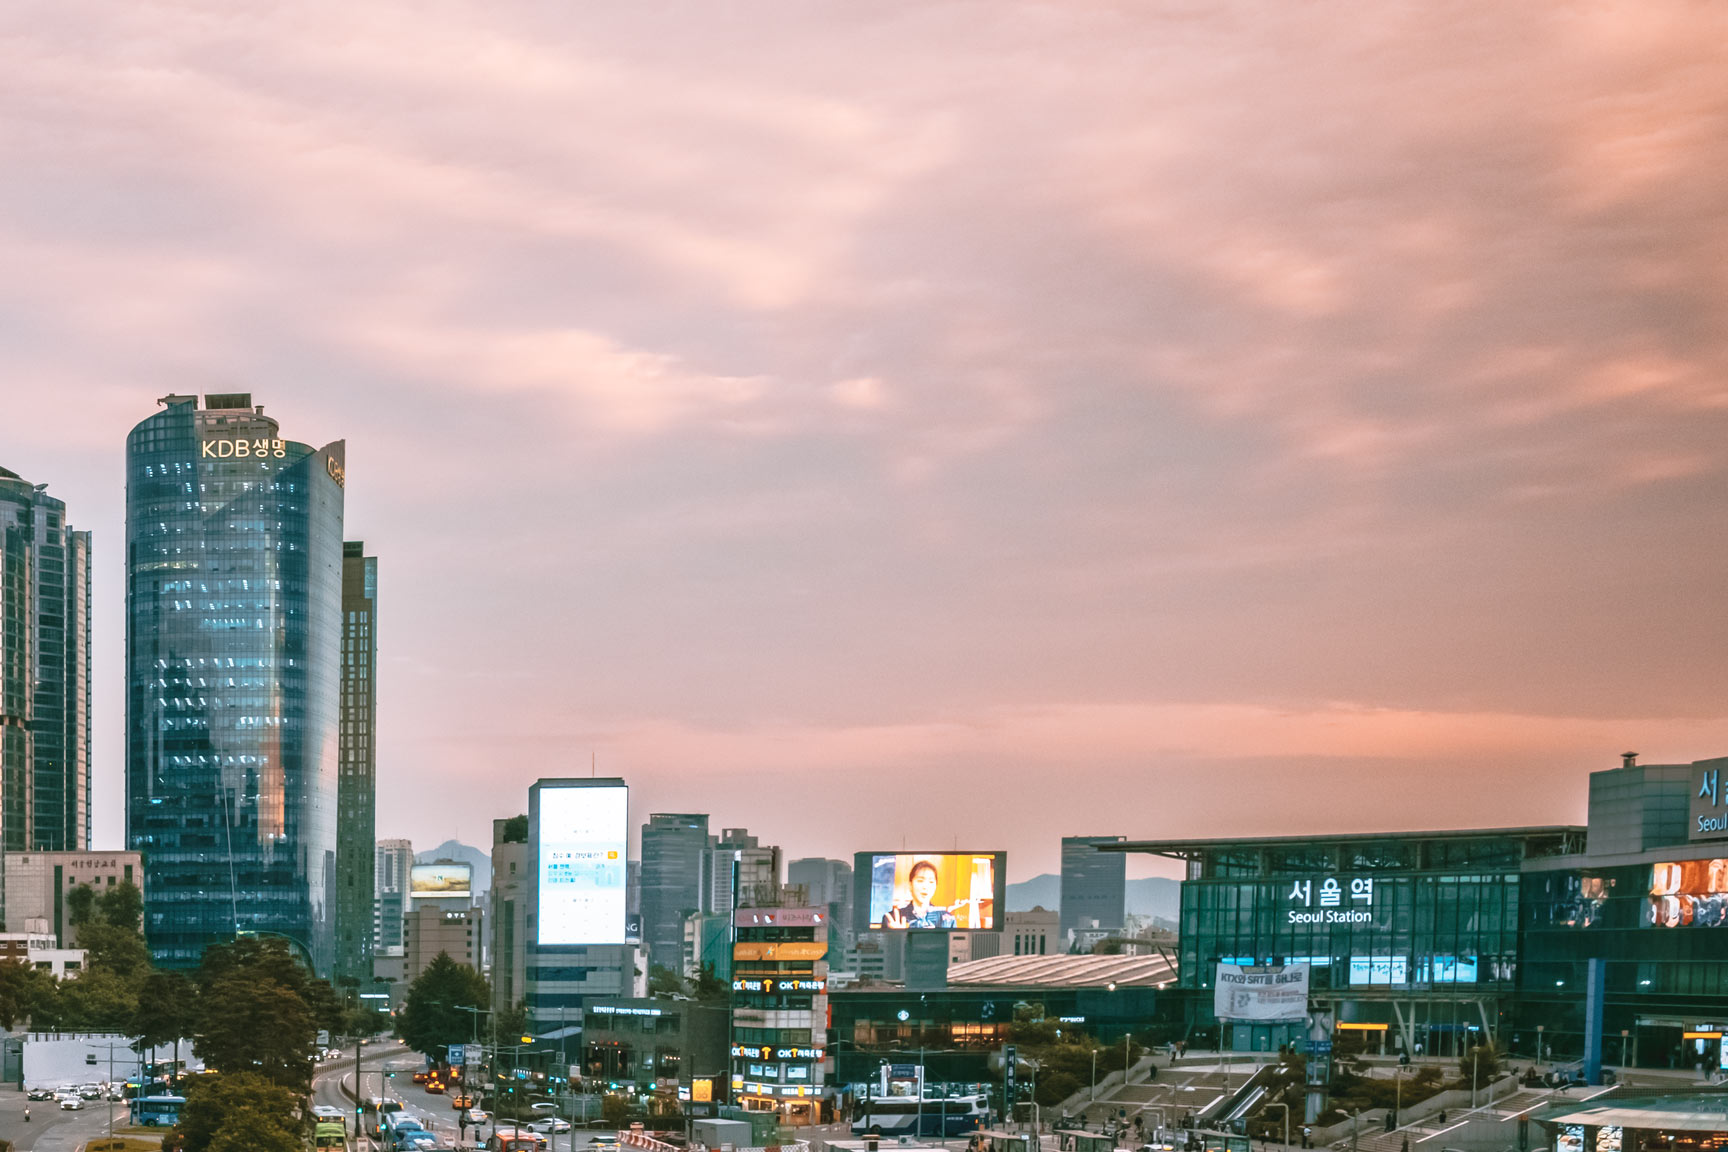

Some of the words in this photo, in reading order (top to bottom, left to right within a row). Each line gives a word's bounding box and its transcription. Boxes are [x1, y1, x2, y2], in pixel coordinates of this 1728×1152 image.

[1699, 769, 1728, 807] 서
[1288, 877, 1373, 907] 서울역
[1288, 910, 1323, 924] Seoul
[1325, 910, 1372, 924] Station
